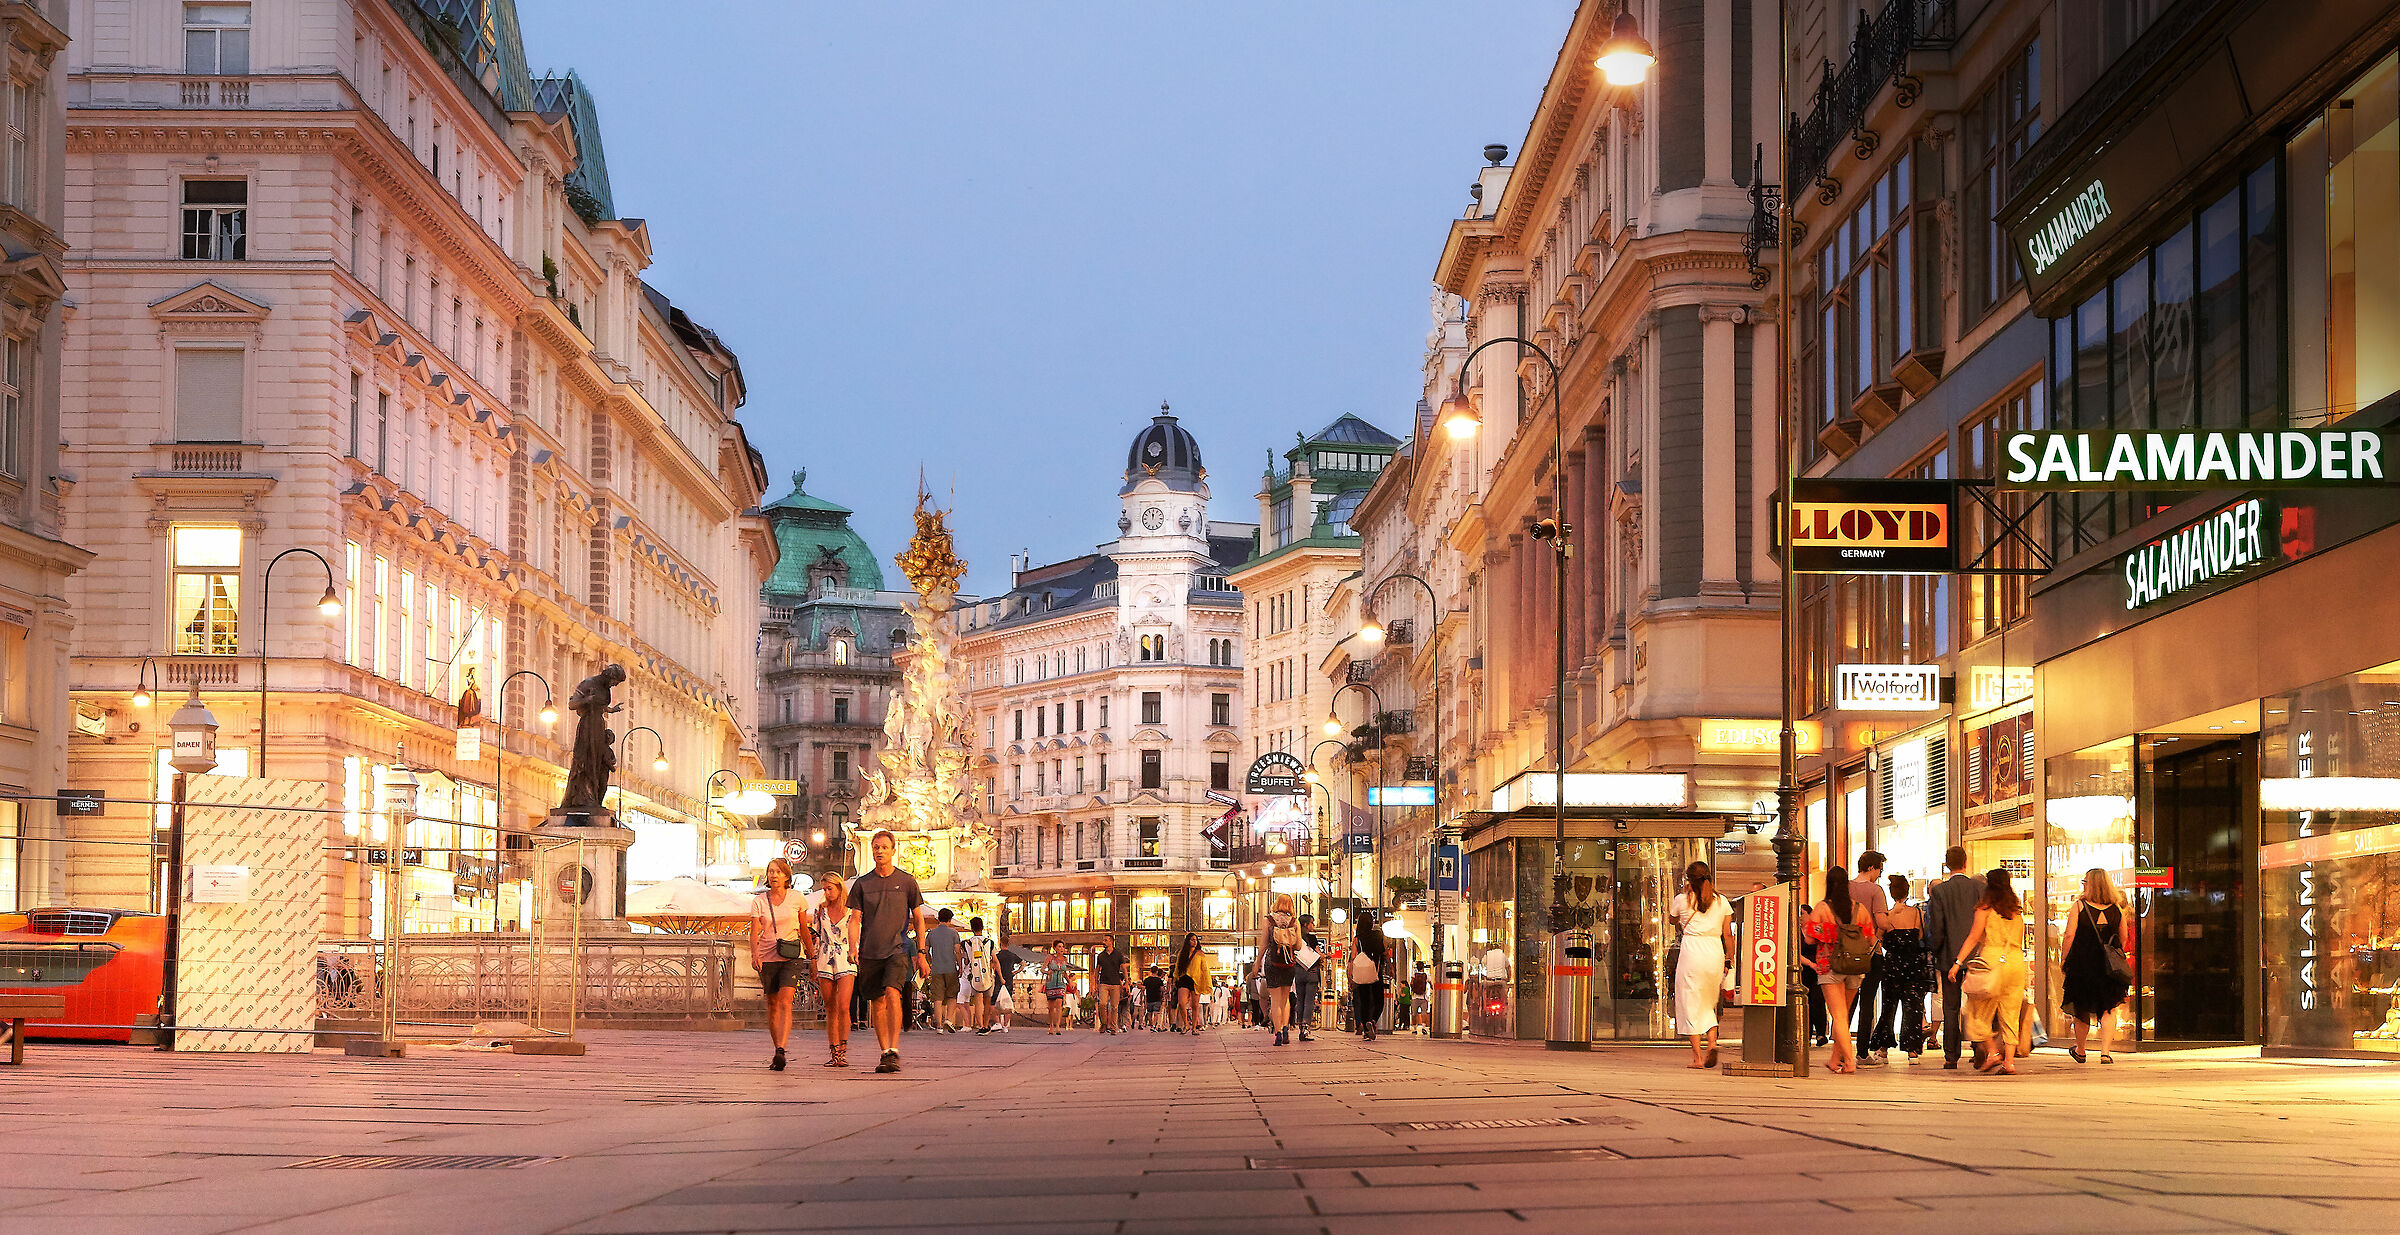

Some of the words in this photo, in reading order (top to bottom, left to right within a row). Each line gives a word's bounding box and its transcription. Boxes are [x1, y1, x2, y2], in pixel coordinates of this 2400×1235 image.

[2029, 179, 2112, 274] SALAMANDER
[2006, 432, 2384, 483] SALAMANDER
[1792, 509, 1941, 540] LLOYD
[1841, 549, 1886, 558] GERMANY
[2126, 498, 2262, 610] SALAMANDER
[1858, 680, 1919, 694] Wolford
[1715, 728, 1809, 745] EDUSCO
[741, 783, 791, 792] VERSACE
[1261, 778, 1295, 786] BUFFET
[2354, 832, 2373, 852] SALE
[2111, 872, 2123, 887] SALE
[1754, 938, 1776, 1003] oe24
